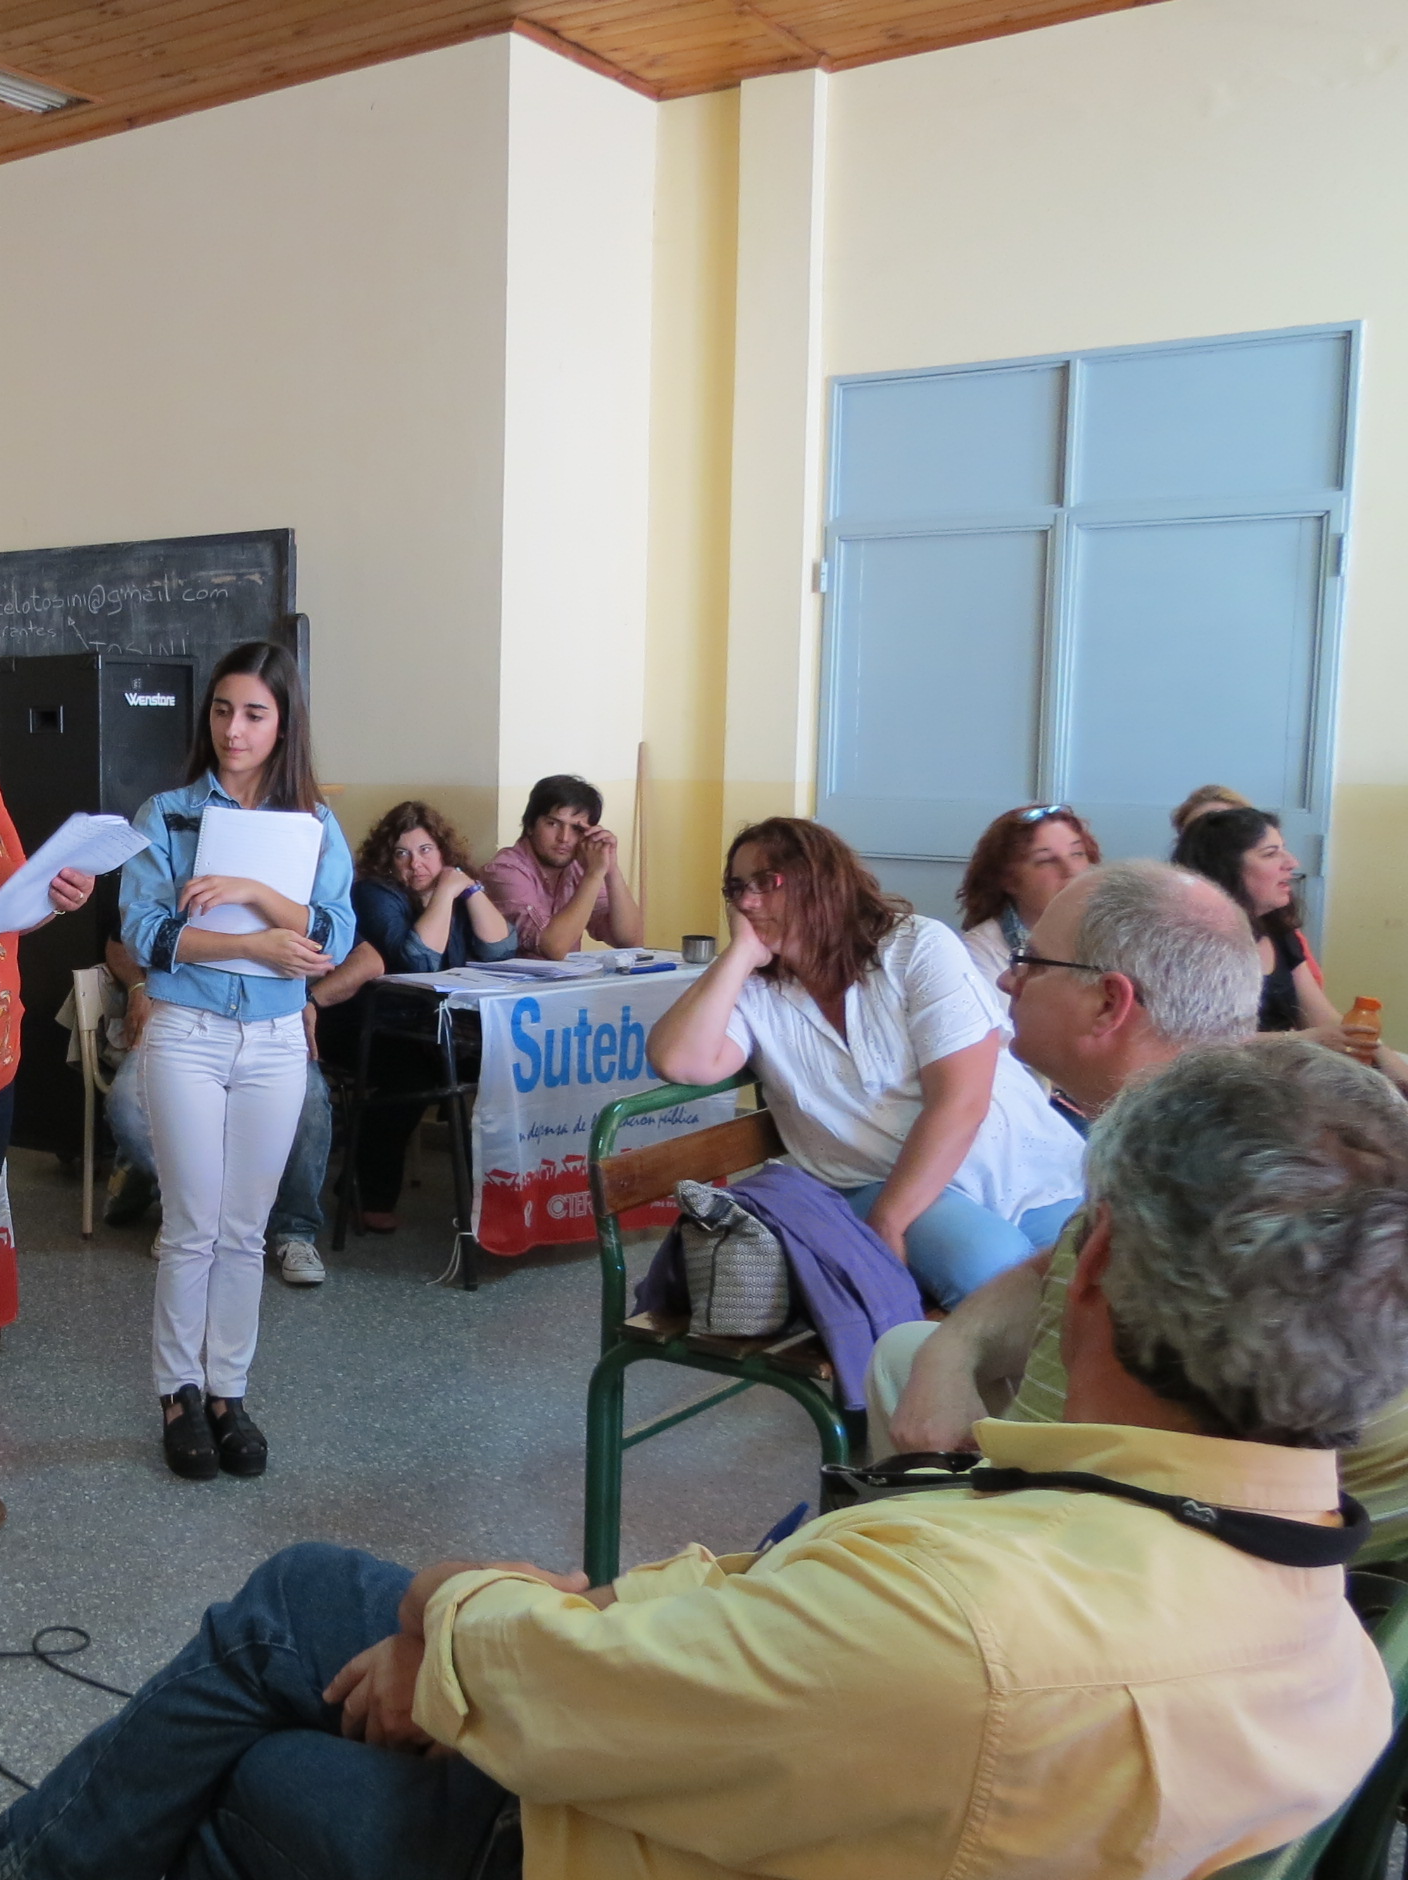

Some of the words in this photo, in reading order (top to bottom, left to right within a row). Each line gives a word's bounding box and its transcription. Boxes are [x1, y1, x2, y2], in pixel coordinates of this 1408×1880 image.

[510, 997, 660, 1094] Suteb
[572, 1114, 586, 1134] de
[546, 1190, 594, 1220] CTER
